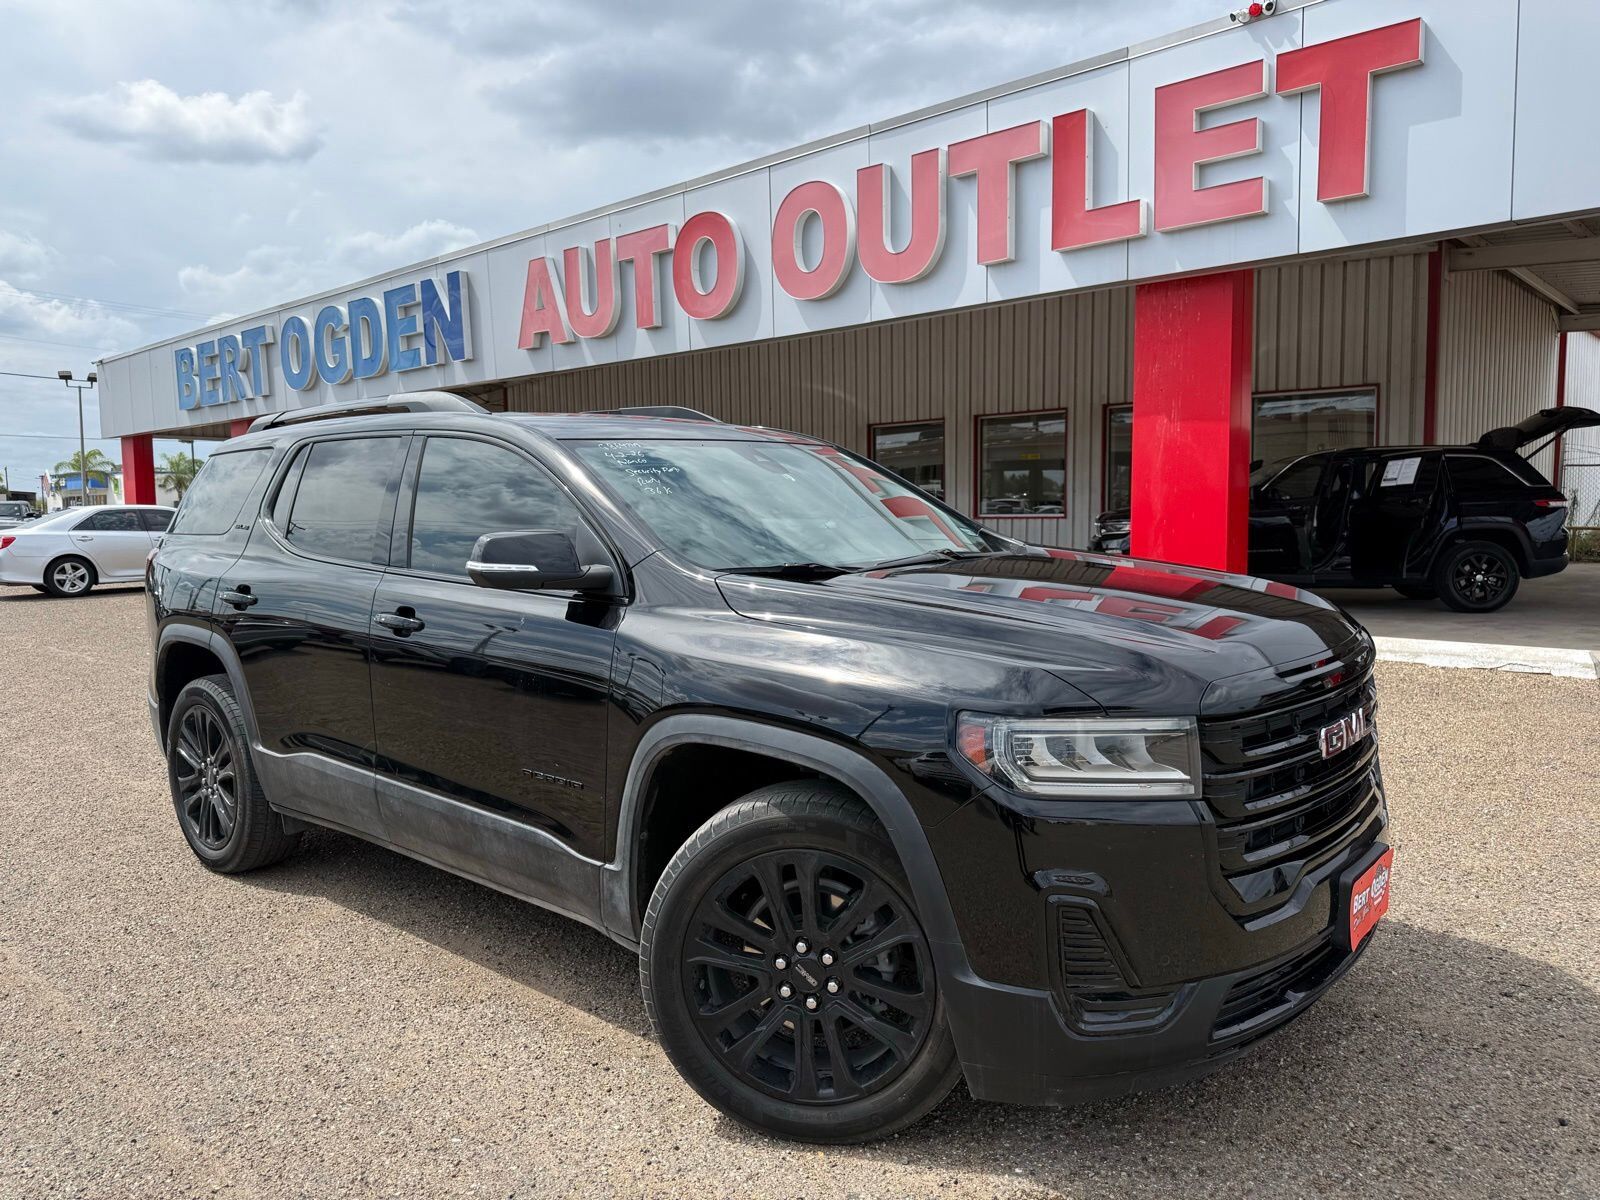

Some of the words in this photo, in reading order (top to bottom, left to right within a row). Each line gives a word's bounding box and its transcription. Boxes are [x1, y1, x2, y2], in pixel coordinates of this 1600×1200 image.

[174, 325, 274, 410] BERT
[280, 270, 473, 391] OGDEN
[518, 211, 745, 350] AUTO
[772, 17, 1425, 300] OUTLET
[1319, 707, 1373, 760] GMC
[1353, 886, 1370, 916] BERT
